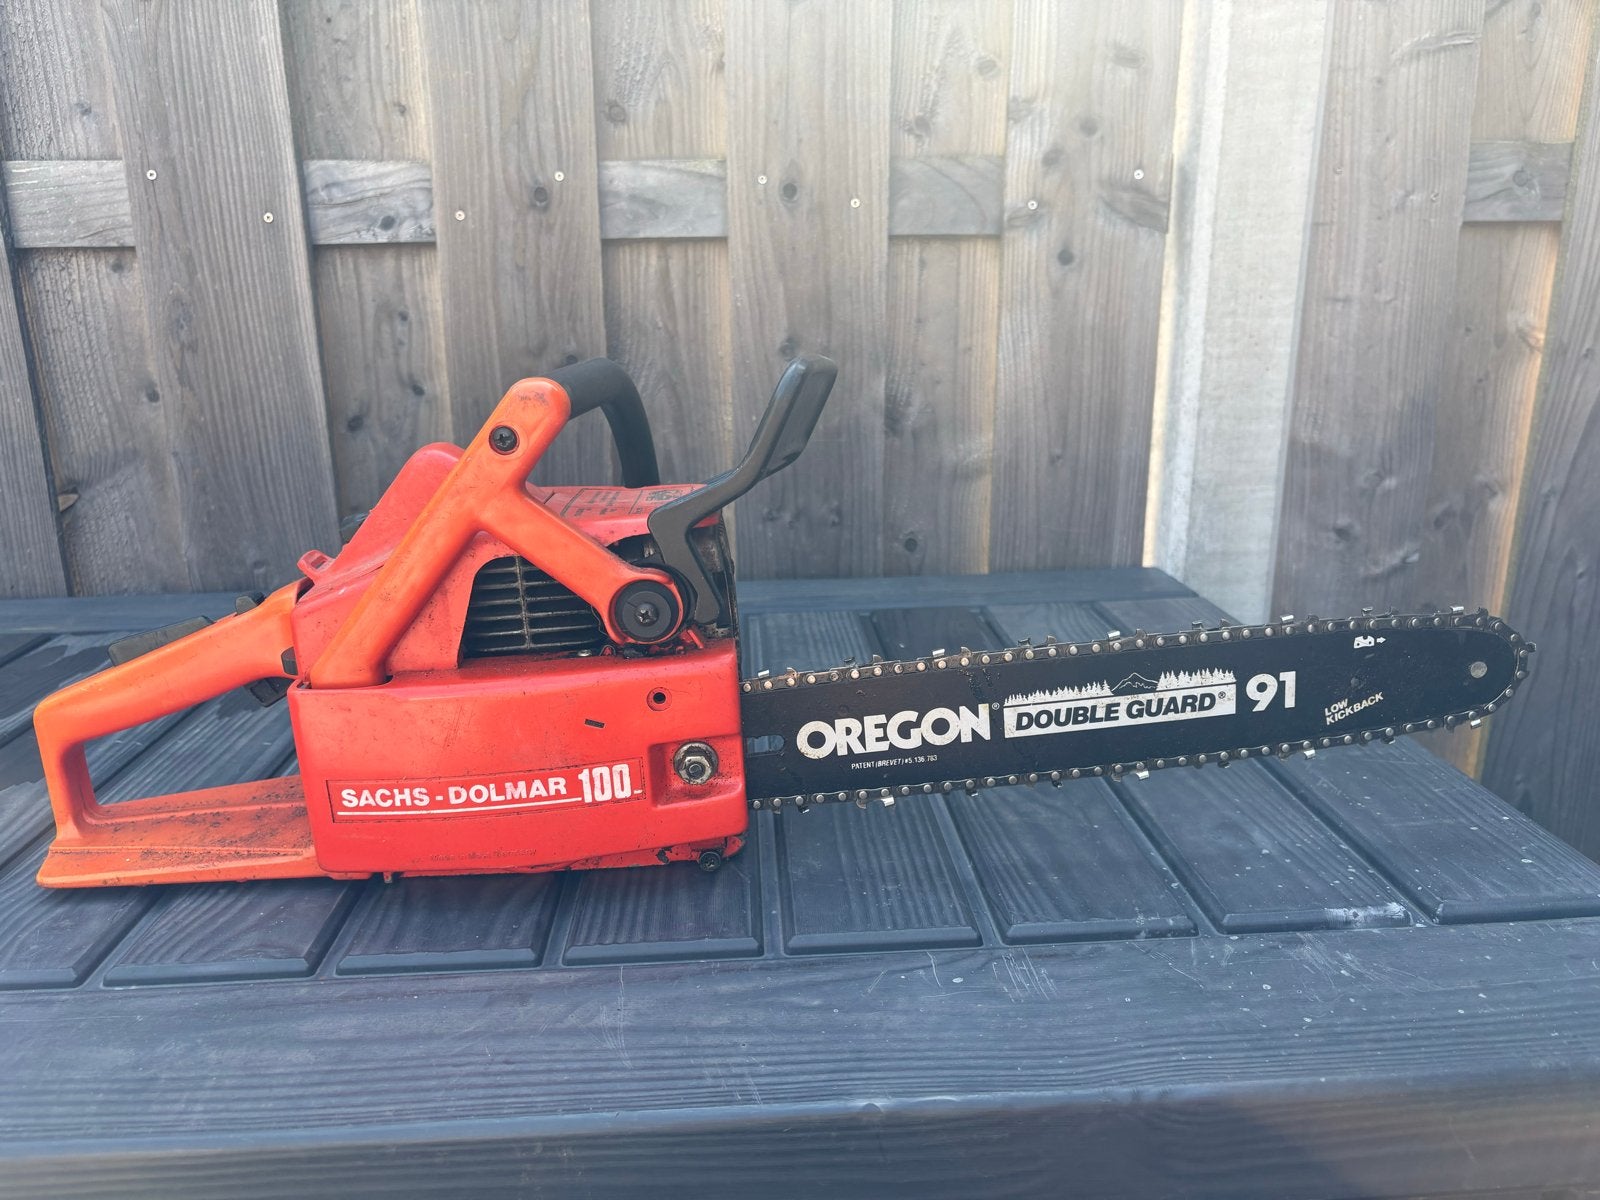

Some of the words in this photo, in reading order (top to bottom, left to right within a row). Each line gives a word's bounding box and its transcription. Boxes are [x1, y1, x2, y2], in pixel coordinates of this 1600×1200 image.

[1245, 670, 1297, 713] 91
[1324, 698, 1349, 717] LOW
[1325, 691, 1384, 726] KICKBACK
[1015, 702, 1121, 731] DOUBLE
[1126, 692, 1217, 720] GUARD
[796, 703, 992, 760] OREGON
[851, 760, 875, 770] PATENT
[875, 757, 904, 769] (BREVET)
[340, 787, 431, 808] SACHS
[447, 776, 568, 805] DOLMAR
[577, 763, 633, 804] 100
